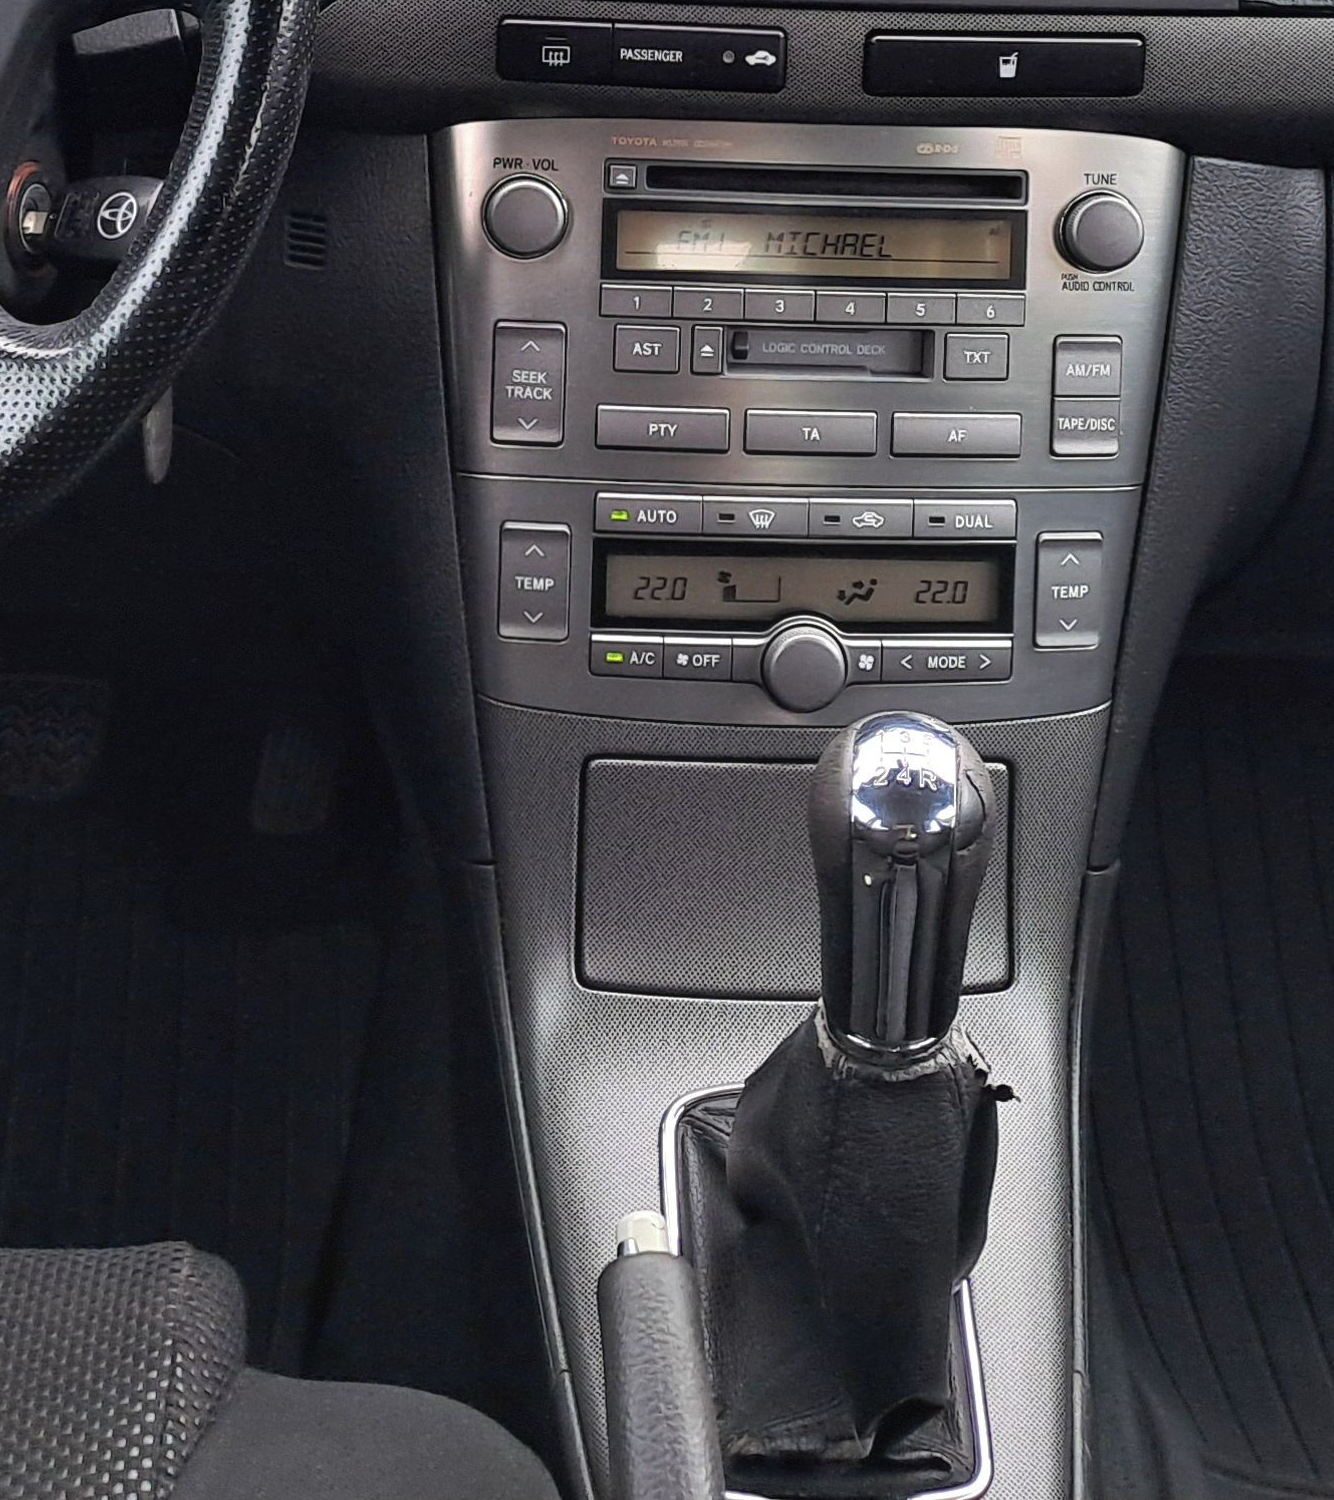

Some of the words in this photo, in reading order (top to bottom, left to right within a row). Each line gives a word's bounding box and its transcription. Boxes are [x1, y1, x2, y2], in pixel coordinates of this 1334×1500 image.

[620, 48, 683, 62] PASSENGER
[612, 136, 657, 148] TOYOTA
[493, 157, 523, 170] PWR
[532, 159, 559, 172] VOL
[1084, 173, 1117, 185] TUNE
[765, 231, 892, 258] MICHAEL
[1062, 281, 1089, 291] AUDIO
[1093, 281, 1135, 292] CONTROL
[633, 296, 640, 310] 1
[703, 298, 713, 312] 2
[775, 299, 785, 313] 3
[845, 302, 856, 315] 4
[916, 303, 926, 317] 5
[986, 305, 995, 318] 6
[632, 342, 662, 356] AST
[762, 342, 796, 354] LOGIC
[800, 343, 851, 355] CONTROL
[856, 344, 885, 356] DECK
[963, 350, 991, 364] TXT
[512, 370, 547, 384] SEEK
[1066, 363, 1111, 377] AM/FM
[506, 386, 552, 400] TRACK
[649, 423, 678, 437] PTY
[1057, 417, 1116, 431] TAPE/DISC
[802, 427, 820, 441] TA
[948, 429, 967, 443] AF
[637, 510, 677, 524] AUTO
[955, 515, 994, 528] DUAL
[515, 575, 555, 591] TEMP
[915, 580, 969, 604] 22.0
[1051, 585, 1089, 599] TEMP
[630, 652, 655, 665] A/C
[693, 654, 721, 667] OFF
[928, 656, 966, 669] MODE
[874, 766, 889, 787] 2
[896, 763, 913, 786] 4
[919, 767, 939, 791] R
